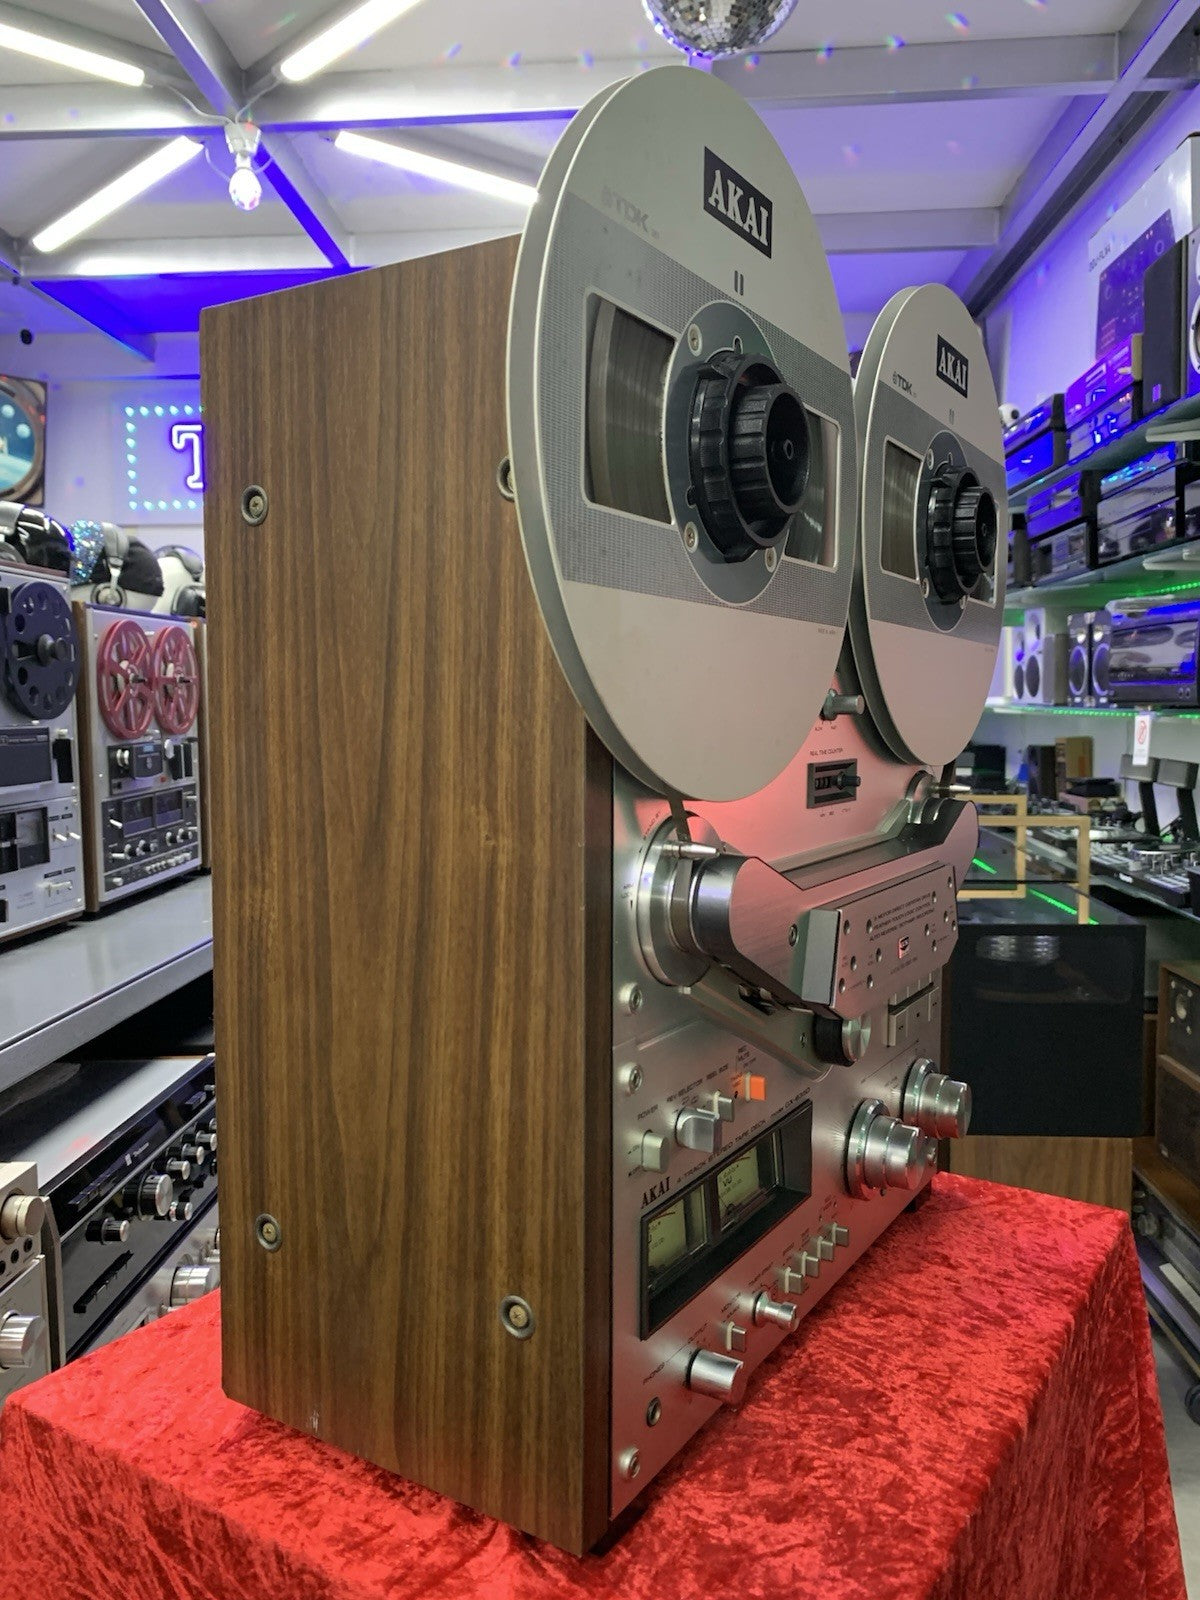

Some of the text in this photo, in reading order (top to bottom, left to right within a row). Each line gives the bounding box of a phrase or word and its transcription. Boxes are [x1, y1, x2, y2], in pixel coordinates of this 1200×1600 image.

[611, 190, 649, 233] TDK
[708, 169, 769, 247] AKAI
[897, 373, 913, 396] TDK
[938, 346, 967, 391] AKAI
[641, 1176, 670, 1210] AKAI
